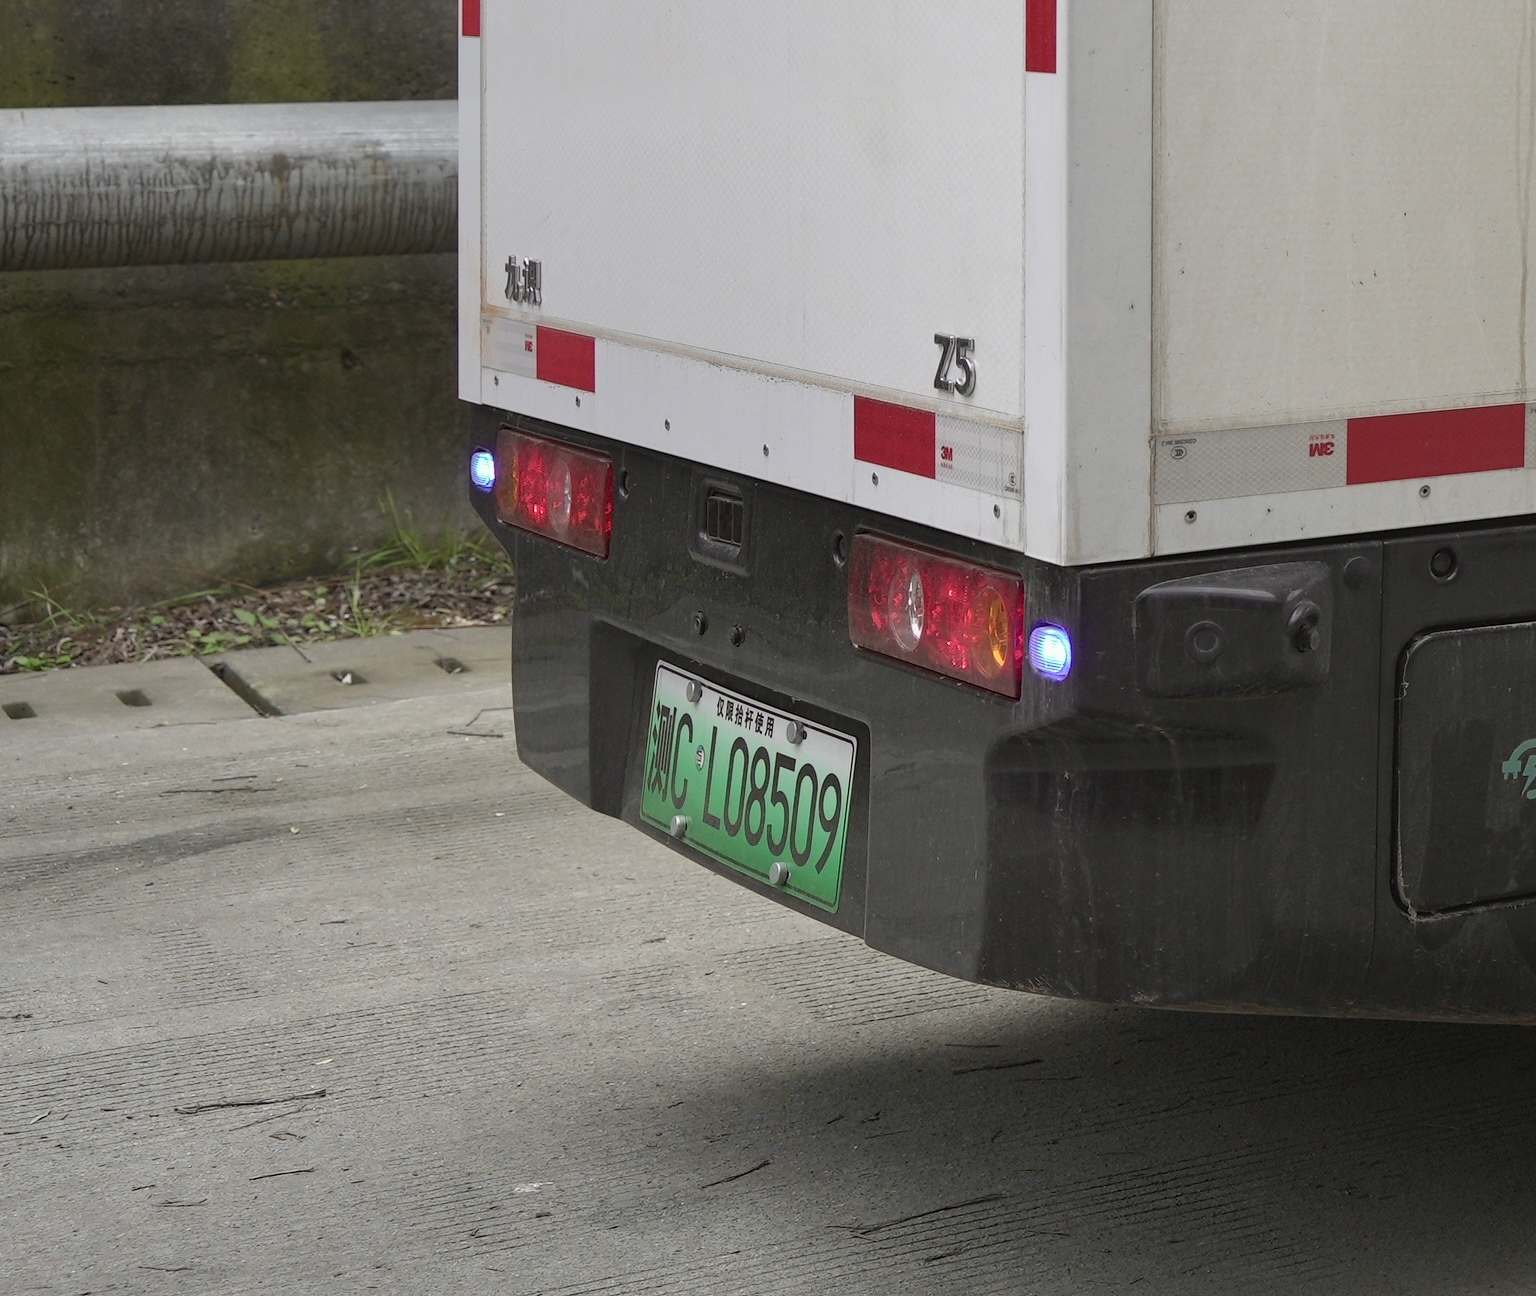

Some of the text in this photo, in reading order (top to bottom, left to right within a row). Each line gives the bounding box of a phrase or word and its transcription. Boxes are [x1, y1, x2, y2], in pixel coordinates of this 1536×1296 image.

[933, 332, 977, 397] Z5
[941, 446, 954, 462] 3M
[1308, 441, 1335, 457] 3M
[716, 696, 775, 739] 仅限抬杆使用
[702, 725, 843, 874] L08509
